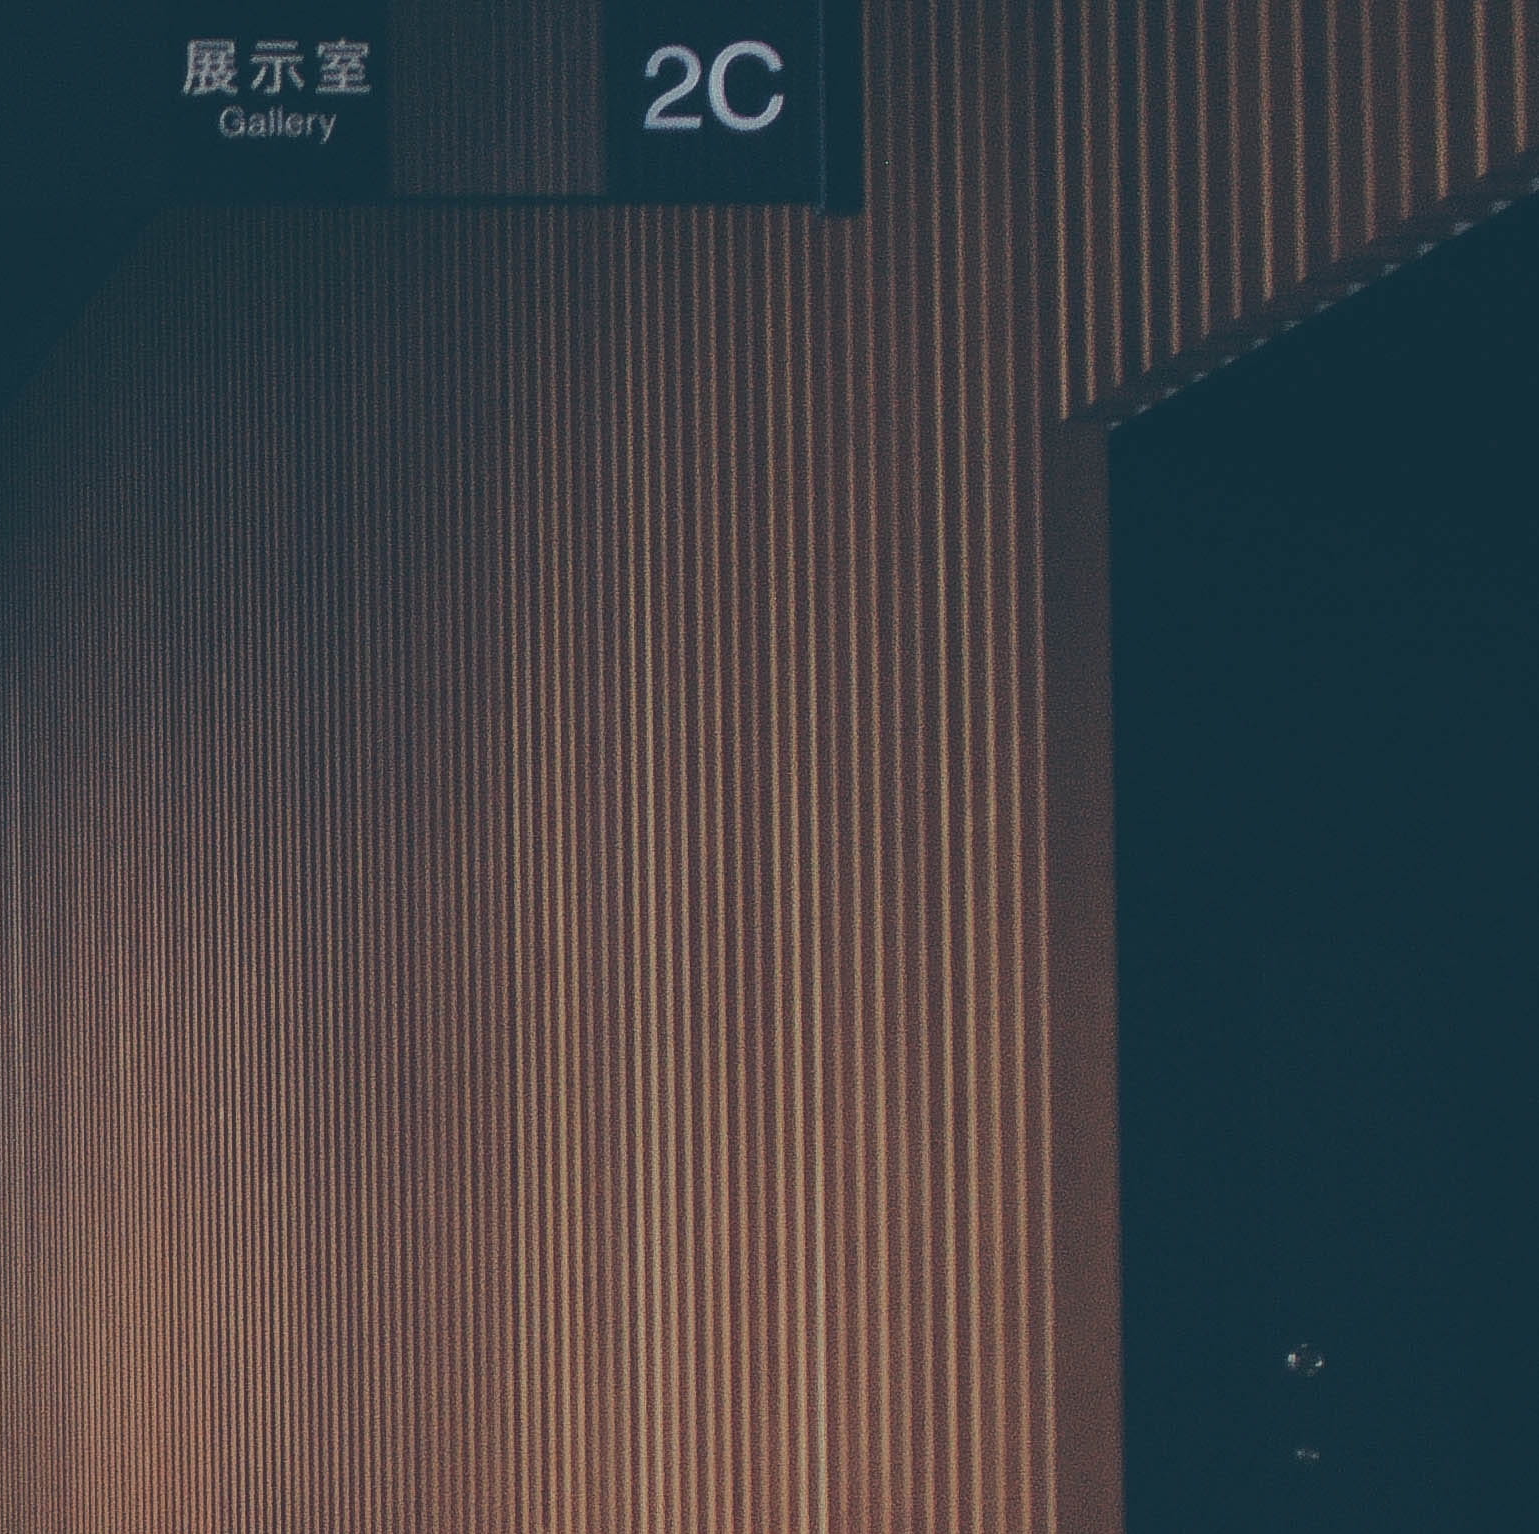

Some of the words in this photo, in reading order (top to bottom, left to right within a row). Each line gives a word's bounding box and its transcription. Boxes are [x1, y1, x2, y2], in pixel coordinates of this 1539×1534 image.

[183, 38, 371, 95] 展示室
[644, 40, 785, 132] 2C
[220, 105, 337, 144] Gallery
